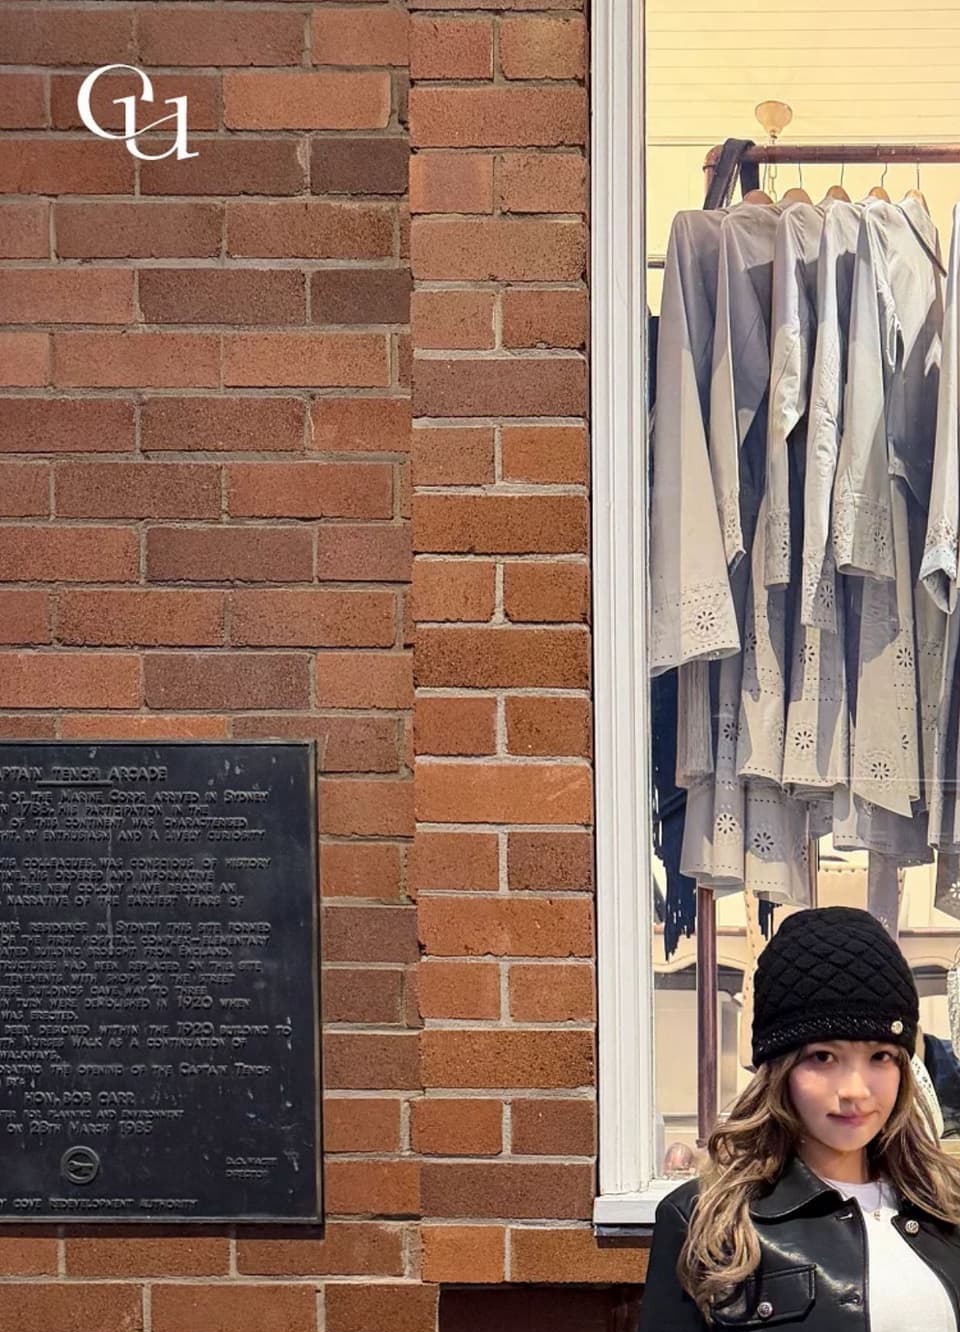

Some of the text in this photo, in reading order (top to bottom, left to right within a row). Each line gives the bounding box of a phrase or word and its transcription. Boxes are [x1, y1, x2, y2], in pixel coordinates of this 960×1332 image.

[0, 766, 168, 782] PTAIN TENCH ARCADE
[10, 790, 25, 803] OF
[31, 790, 53, 803] THE
[154, 790, 200, 803] ARRIVED
[205, 790, 217, 803] IN
[223, 789, 270, 804] SYDNEY
[86, 804, 163, 816] PARTICIPATION
[172, 804, 183, 816] IN
[189, 804, 209, 816] THE
[10, 817, 25, 829] OF
[65, 817, 124, 829] CONTINENT
[131, 817, 154, 829] WAS
[44, 830, 110, 842] ENTHUSIASM
[118, 830, 143, 842] AND
[150, 830, 160, 842] A
[207, 830, 266, 842] CURIOSITY
[99, 857, 123, 869] WAS
[130, 857, 194, 869] CONSCIOUS
[202, 857, 217, 869] OF
[225, 857, 271, 869] HISTORY
[55, 870, 103, 882] ORDERED
[110, 870, 134, 882] AND
[141, 870, 215, 882] INFORMATIVE
[20, 883, 41, 895] THE
[47, 883, 71, 895] NEW
[77, 883, 124, 895] COLONY
[132, 883, 160, 895] HAVE
[7, 895, 69, 907] NARRATIVE
[75, 895, 91, 907] OF
[97, 895, 120, 907] THE
[185, 895, 220, 907] YEARS
[229, 895, 245, 907] OF
[30, 922, 89, 934] RESIDENCE
[116, 920, 161, 934] SYDNEY
[166, 922, 192, 934] THIS
[228, 922, 272, 934] FORMED
[208, 960, 234, 971] THIS
[71, 973, 97, 984] WITH
[124, 985, 147, 997] WAY
[177, 995, 213, 1009] 1920
[177, 1021, 214, 1036] 1920
[275, 1025, 292, 1036] TO
[108, 1037, 123, 1048] AS
[130, 1037, 140, 1048] A
[146, 1037, 226, 1048] CONTINUATION
[231, 1037, 248, 1048] OF
[50, 1064, 72, 1075] THE
[78, 1064, 124, 1075] OPENING
[131, 1064, 148, 1075] OF
[63, 1091, 92, 1105] BOB
[98, 1091, 136, 1105] CARR
[96, 1109, 117, 1120] AND
[69, 1120, 110, 1135] MARCH
[140, 1198, 198, 1208] AUTHORITY
